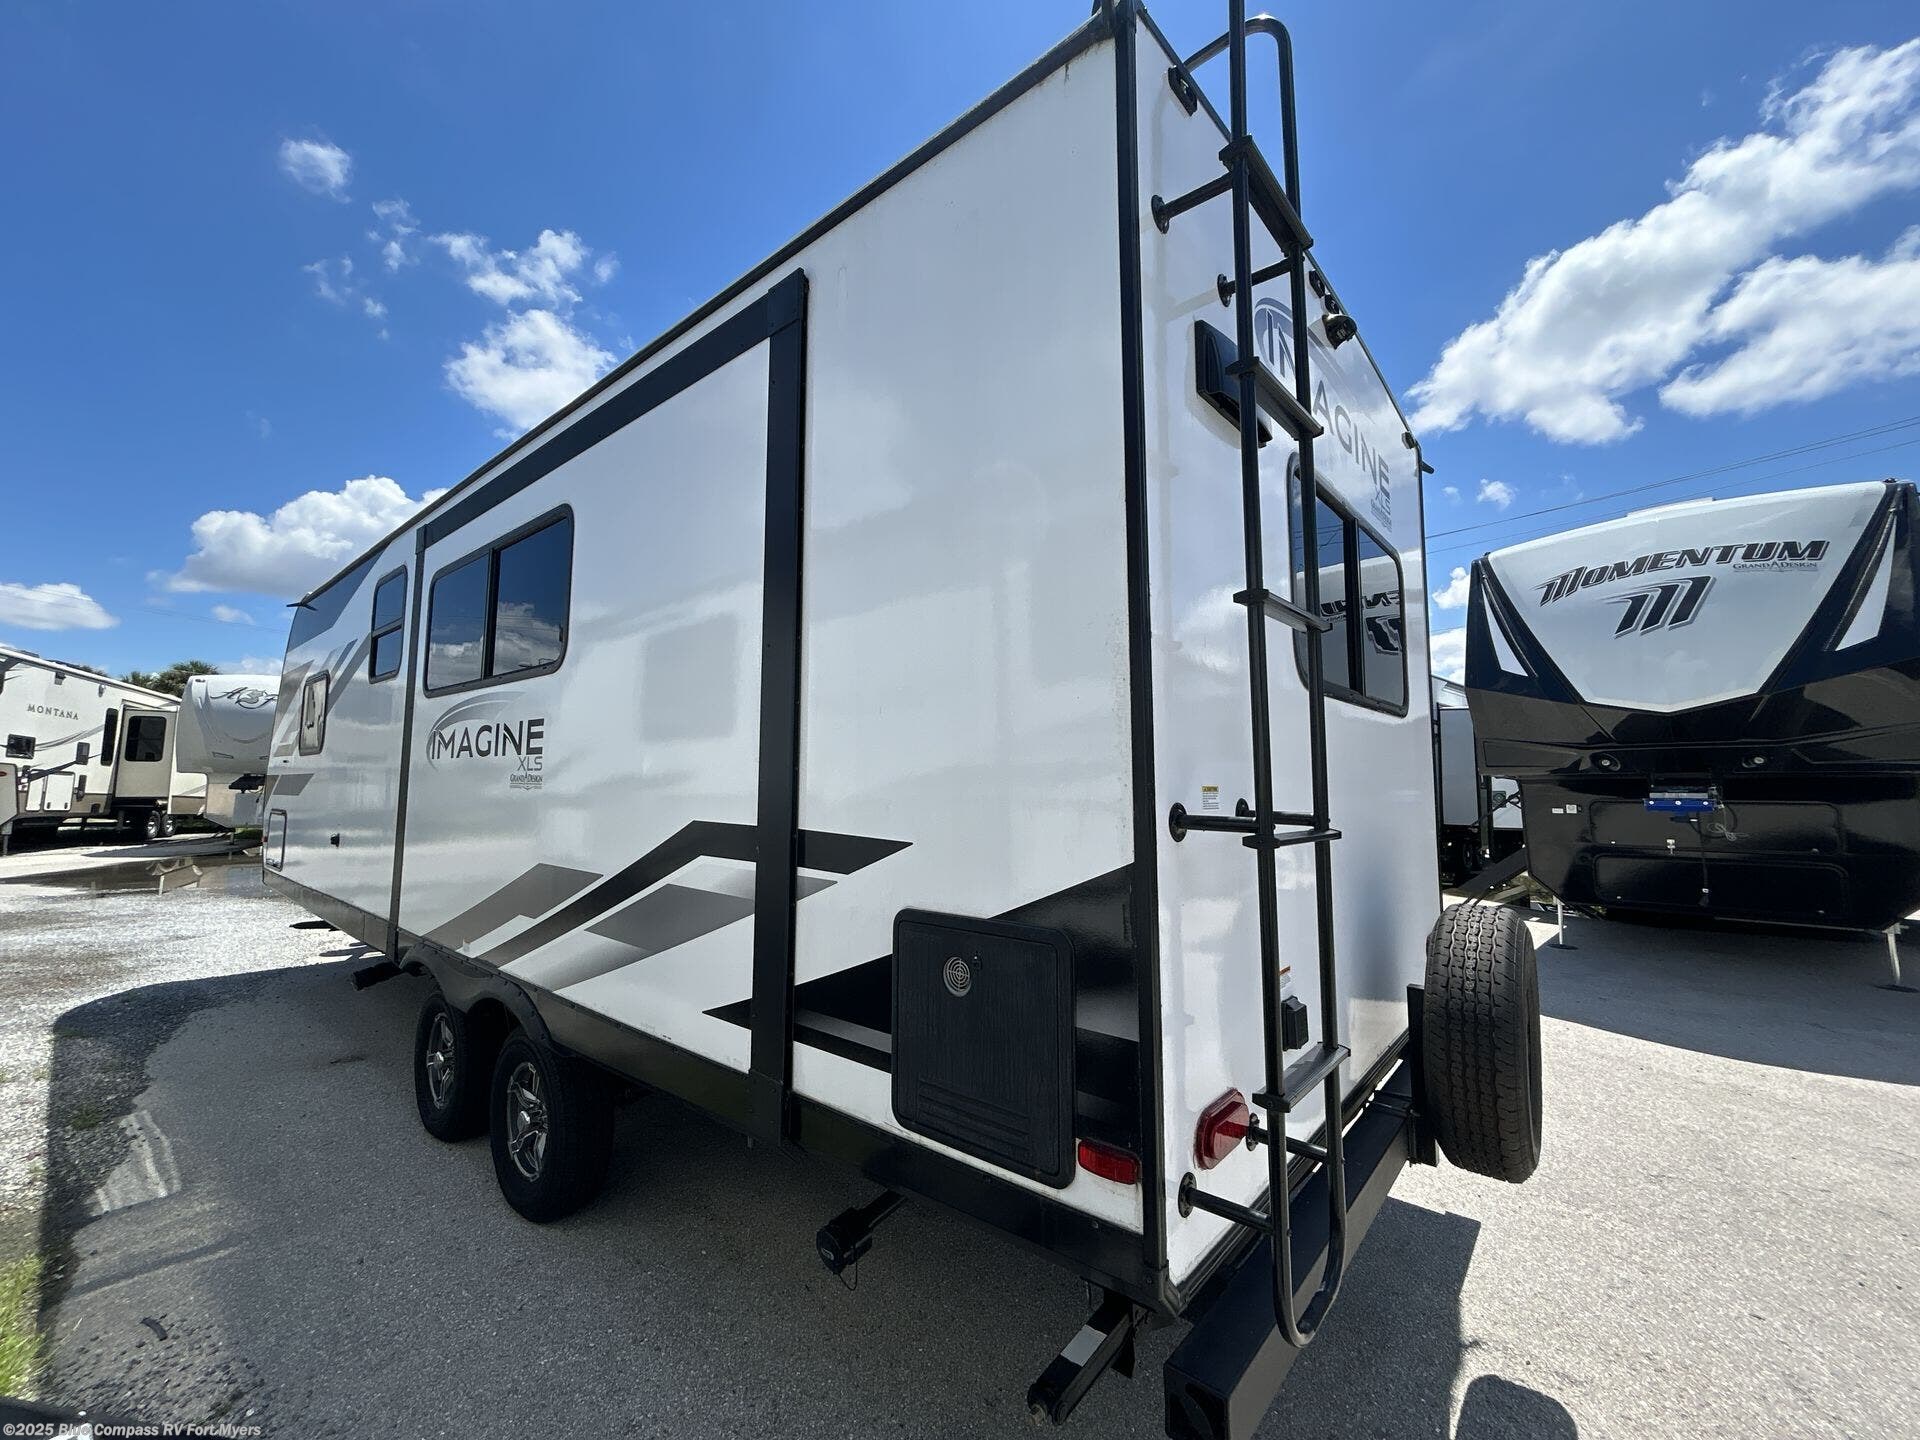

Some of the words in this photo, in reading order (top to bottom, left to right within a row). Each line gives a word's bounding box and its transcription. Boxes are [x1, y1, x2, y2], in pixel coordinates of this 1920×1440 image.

[1534, 541, 1830, 607] MOMENTUM
[27, 703, 79, 721] MONTANA
[431, 718, 545, 759] IMAGINE
[517, 756, 543, 771] XLS
